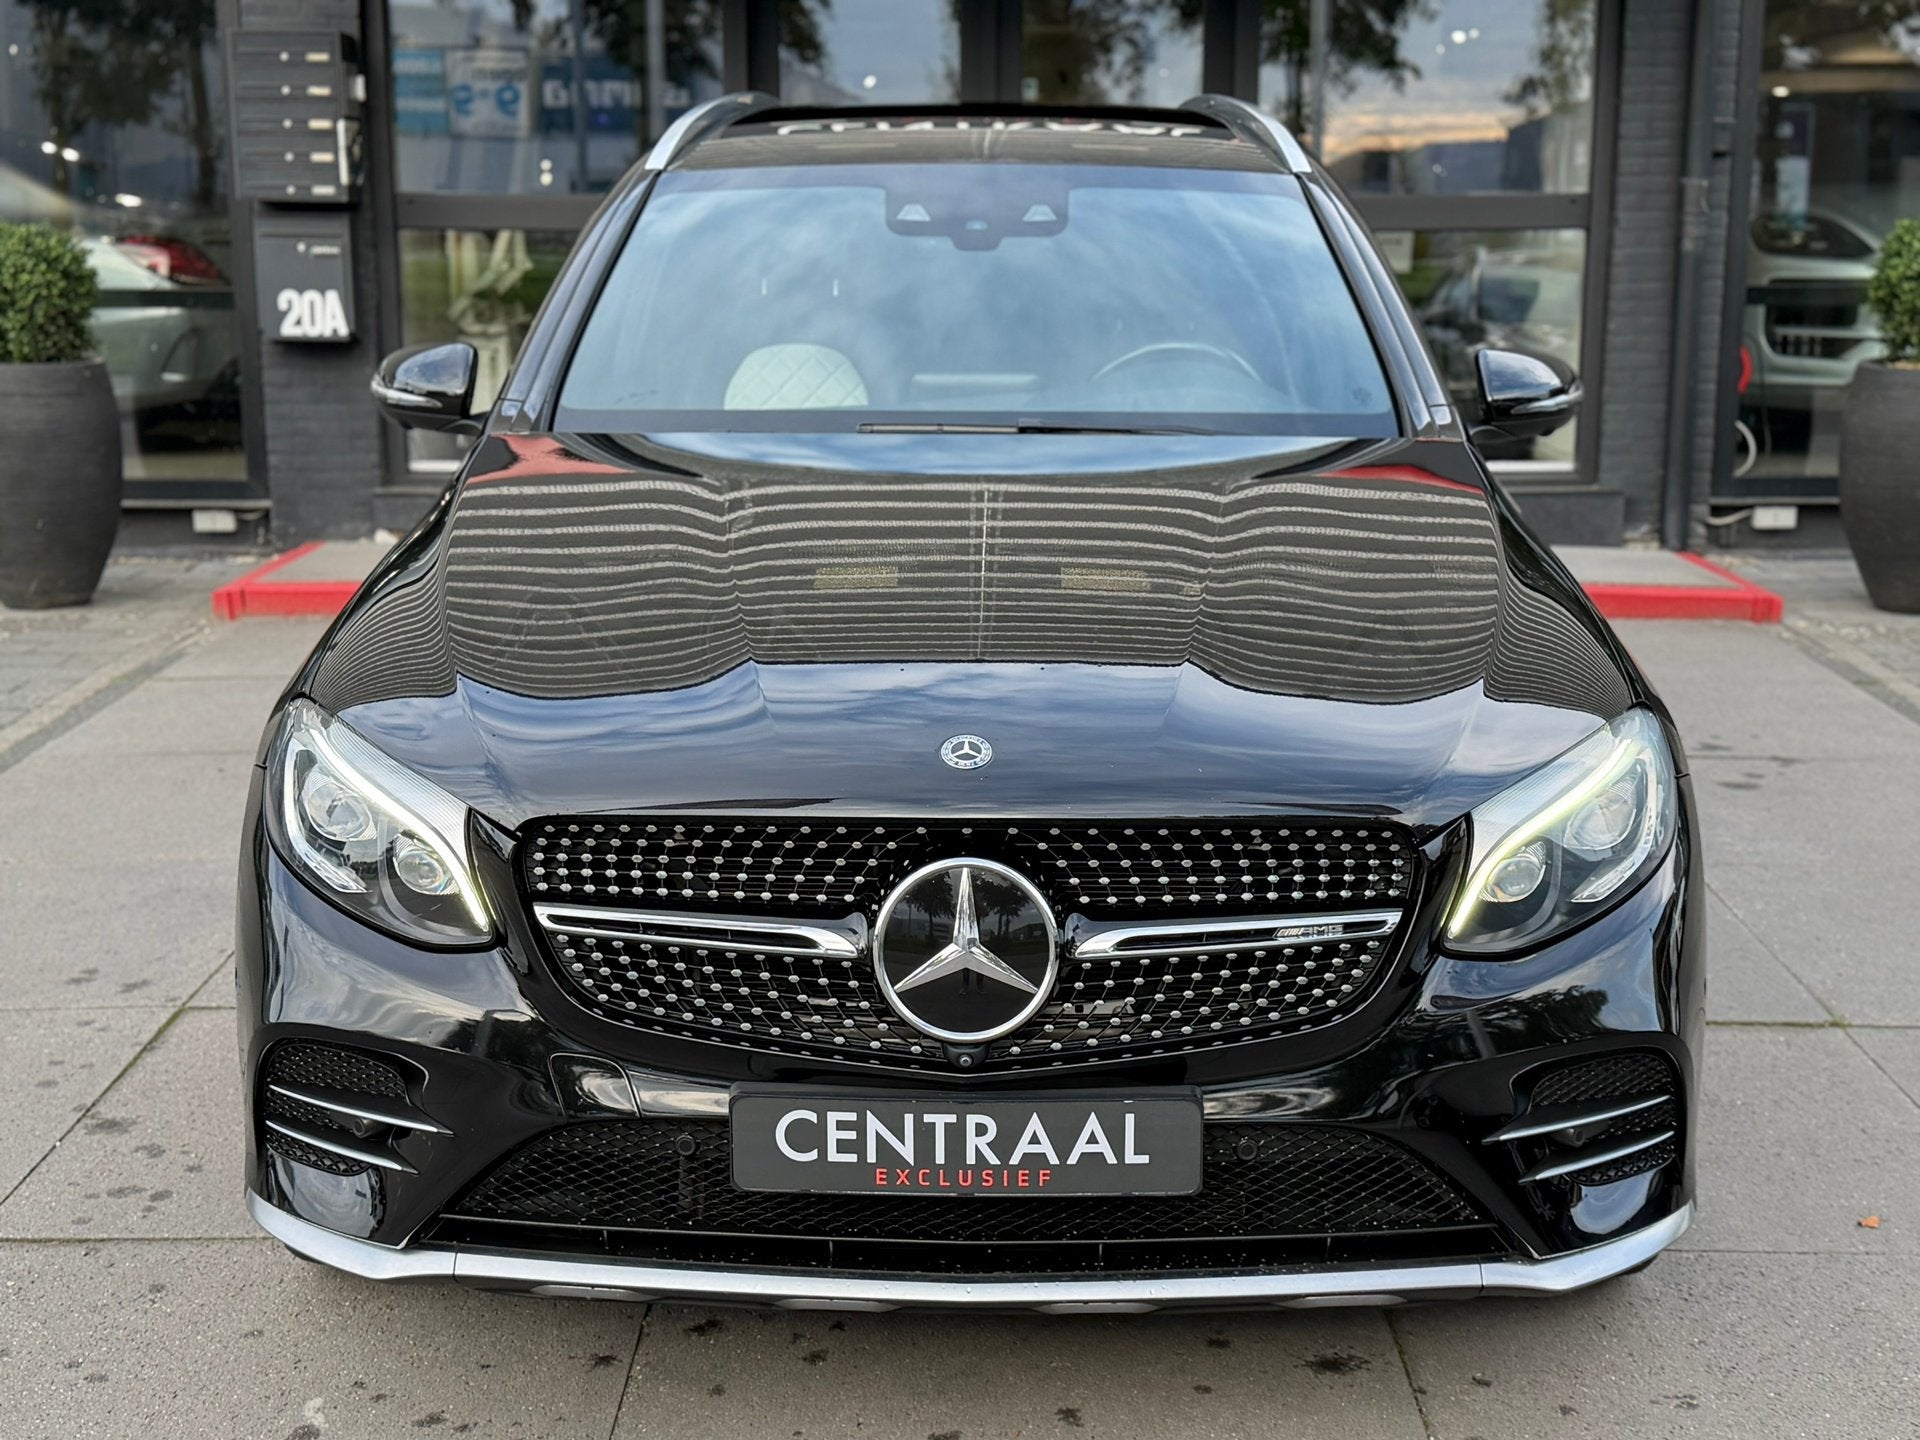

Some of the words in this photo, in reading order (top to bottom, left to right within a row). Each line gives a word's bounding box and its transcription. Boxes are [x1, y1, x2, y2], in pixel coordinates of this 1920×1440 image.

[276, 287, 350, 338] 20A
[775, 1109, 1150, 1167] CENTRAAL
[875, 1168, 1052, 1187] EXCLUSIEF
